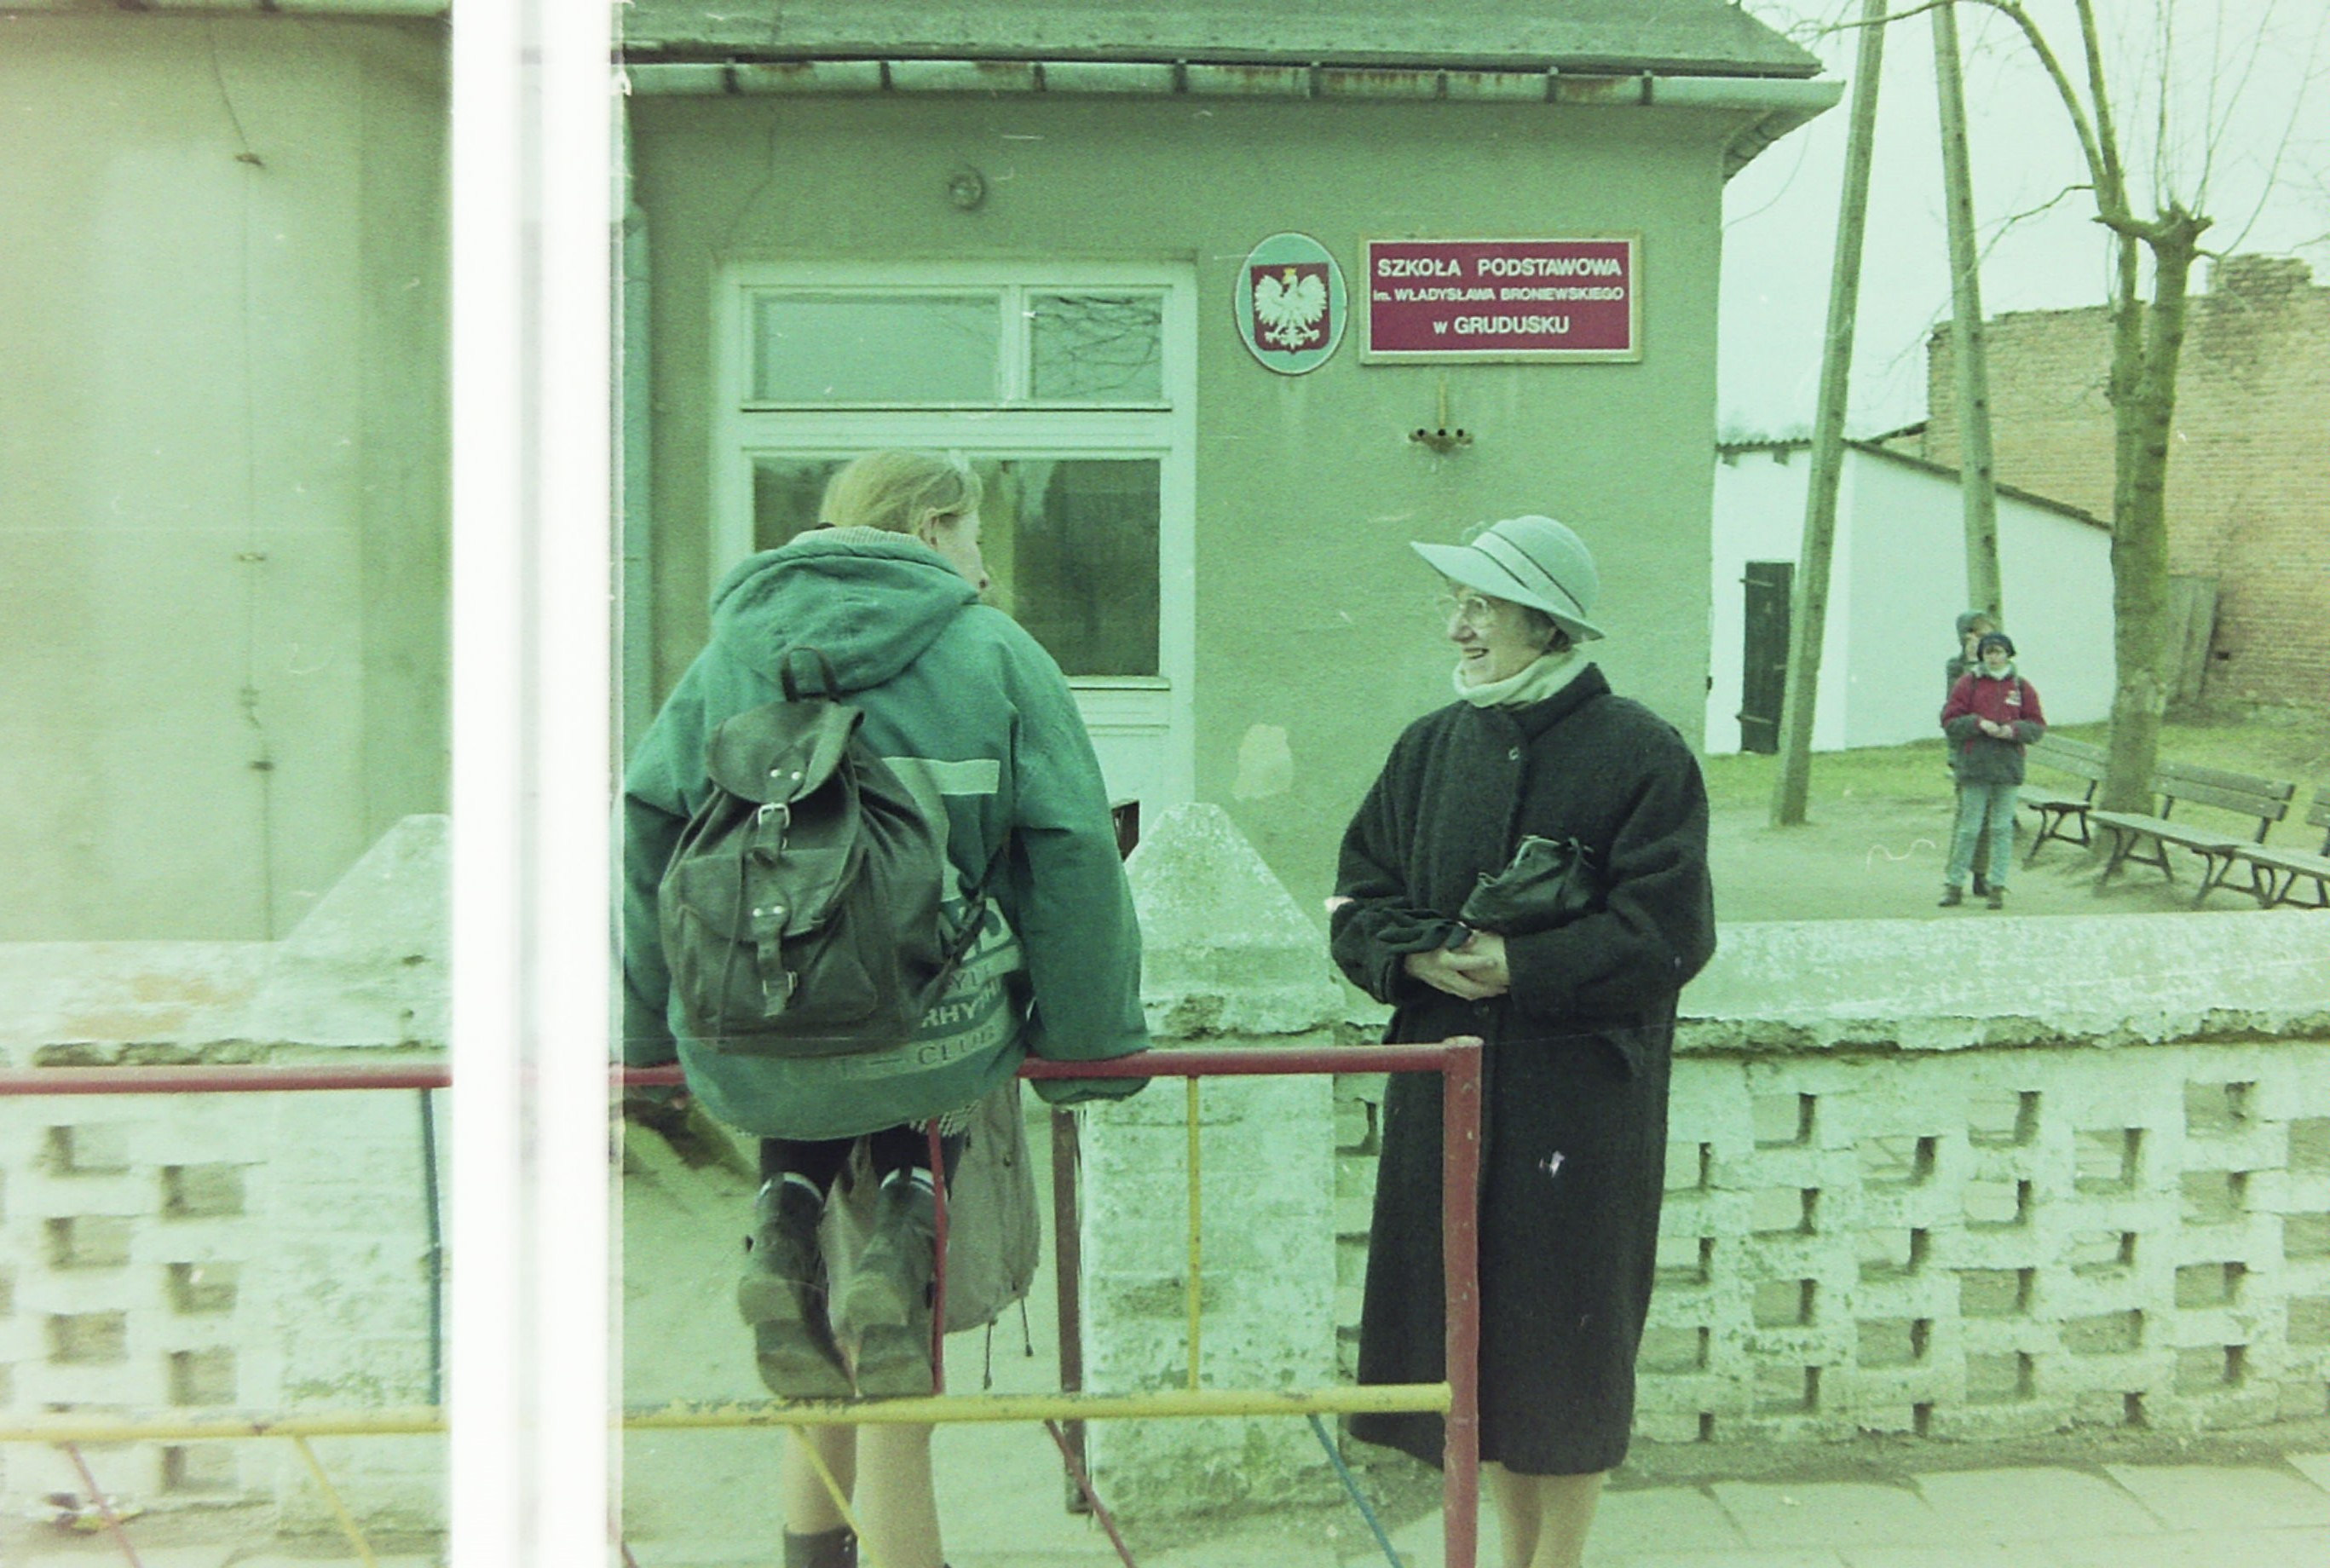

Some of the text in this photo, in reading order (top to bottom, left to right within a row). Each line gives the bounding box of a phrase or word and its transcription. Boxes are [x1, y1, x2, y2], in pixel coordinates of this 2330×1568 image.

[1377, 257, 1623, 277] SZKOŁA PODSTAWOWA
[1393, 287, 1496, 301] WŁADYSŁAWA
[1501, 286, 1624, 301] BRONIEWSKIEGO
[1453, 315, 1570, 335] GRUDUSKU
